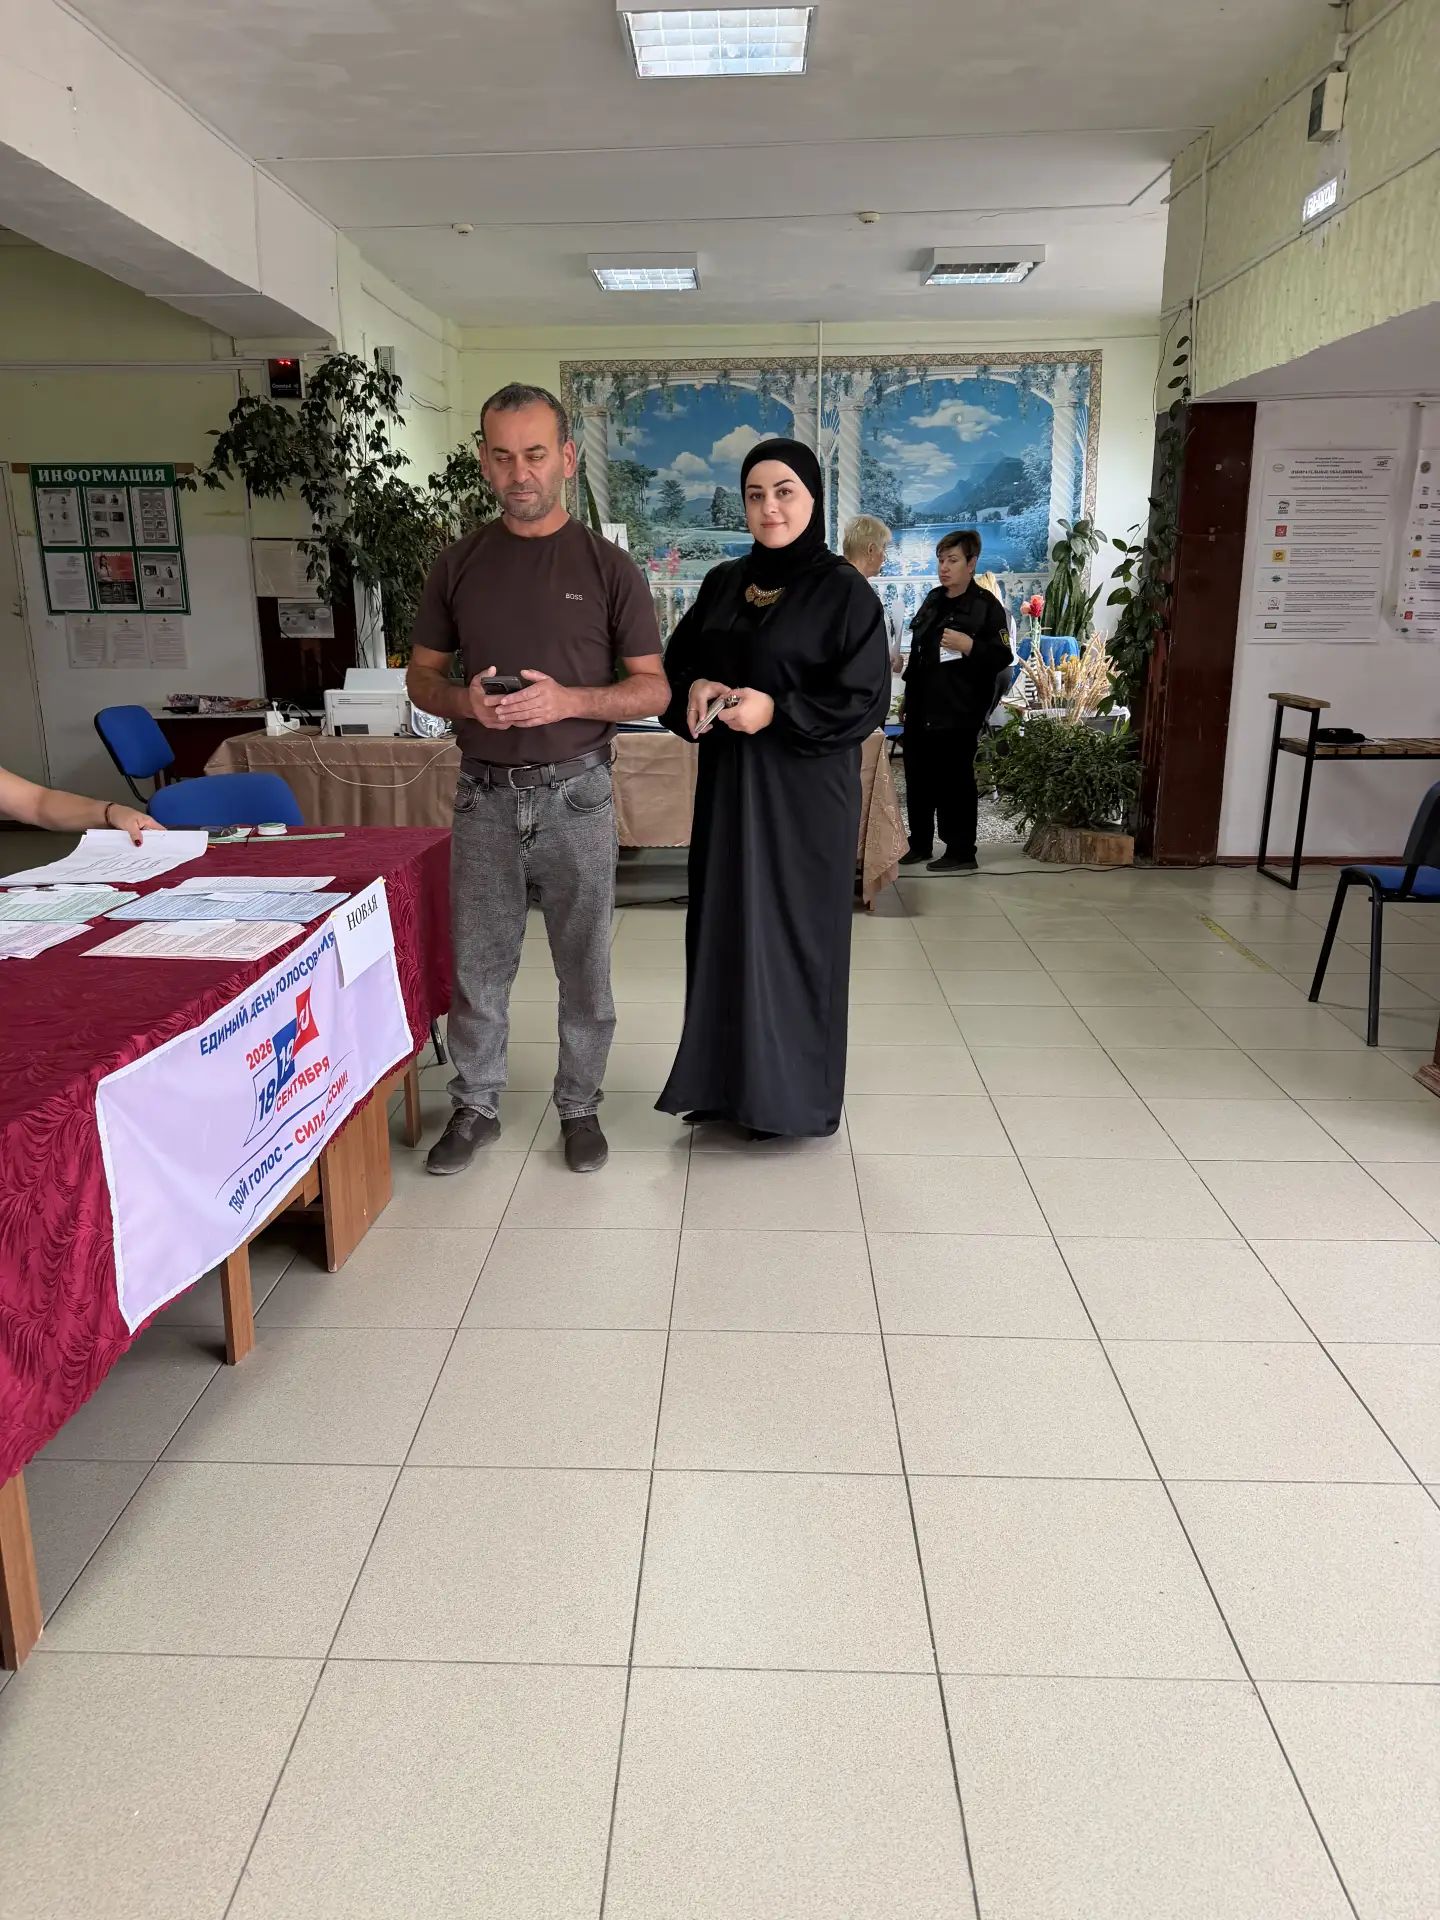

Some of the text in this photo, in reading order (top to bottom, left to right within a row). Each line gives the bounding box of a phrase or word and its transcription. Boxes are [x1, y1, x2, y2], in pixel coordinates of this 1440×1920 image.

[37, 468, 167, 484] ИНФОРМАЦИЯ
[565, 592, 583, 601] BOSS
[346, 894, 378, 931] НОВАЯ
[200, 1004, 249, 1056] ЕДИНЫЙ
[250, 988, 275, 1022] ДЕНЬ
[246, 1038, 273, 1070] 2026
[258, 1078, 276, 1122] 18
[275, 1056, 330, 1112] СЕНТЯБРЯ
[228, 1178, 250, 1214] ТВОЙ
[248, 1146, 283, 1190] ГОЛОС
[294, 1109, 325, 1144] СИЛА
